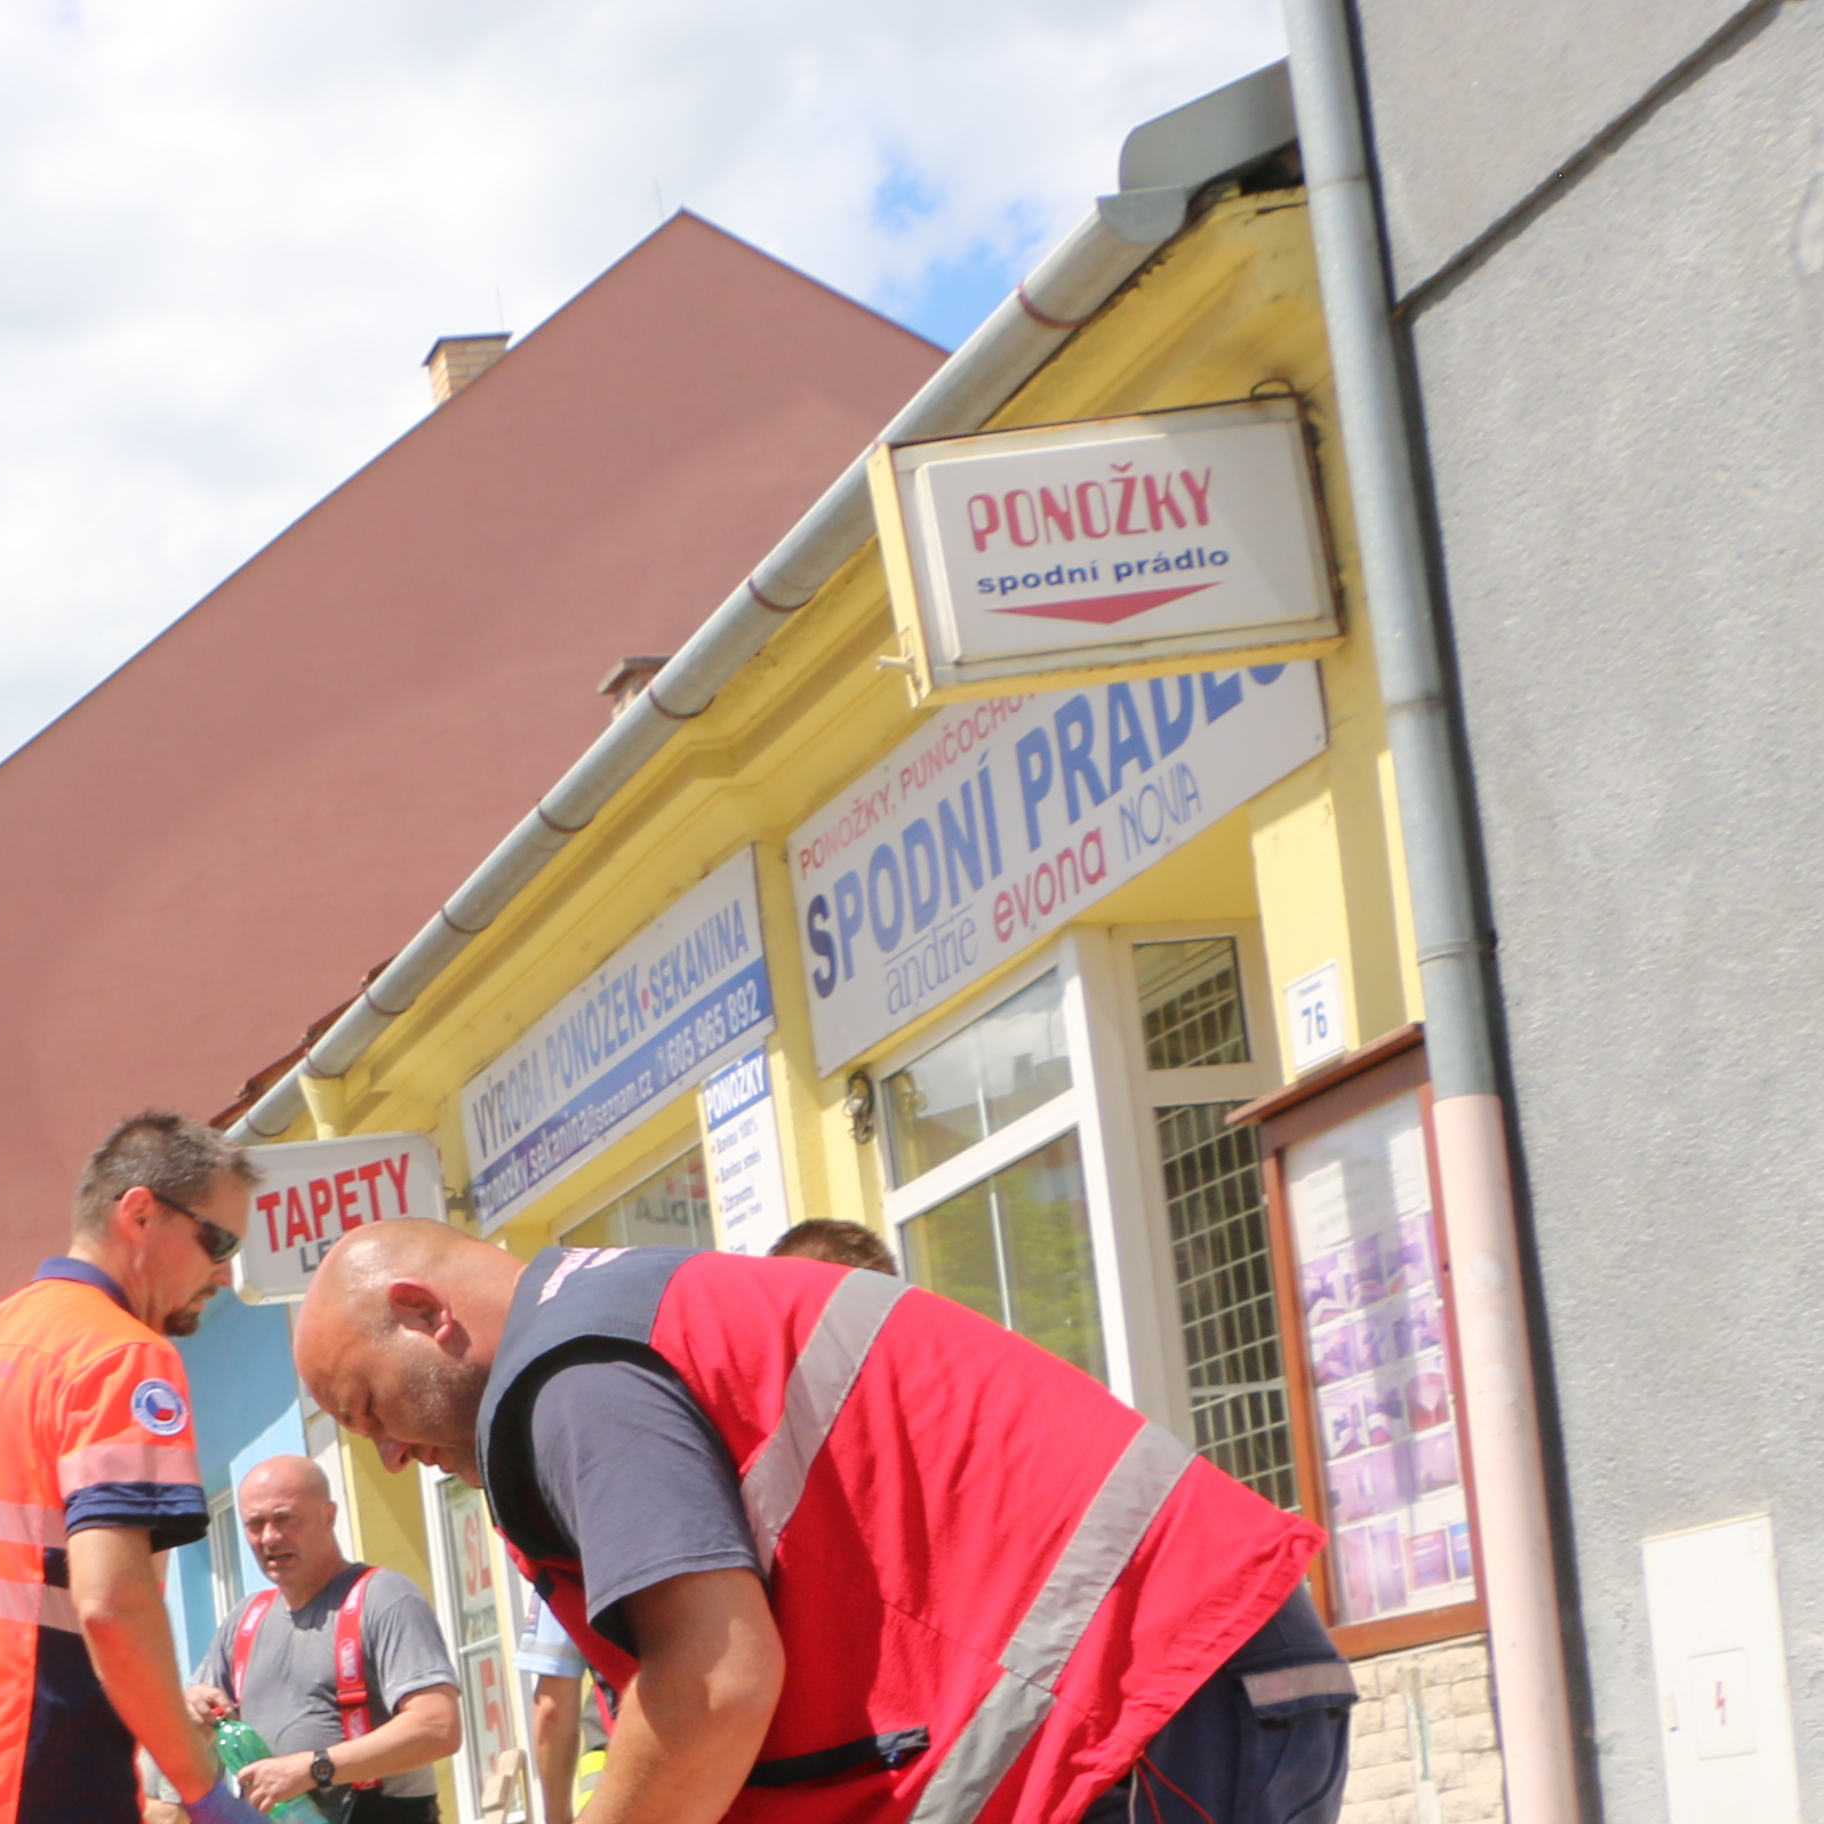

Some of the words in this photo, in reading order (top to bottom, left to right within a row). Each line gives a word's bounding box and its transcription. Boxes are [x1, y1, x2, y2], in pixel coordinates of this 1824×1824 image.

[968, 461, 1212, 552] PONOŽKY
[977, 560, 1100, 595] spodní
[1114, 547, 1230, 583] prádlo
[898, 692, 1037, 803] PUNČOCHO
[806, 747, 1003, 999] SPODNÍ
[993, 826, 1108, 943] evona
[472, 1050, 547, 1159] VÝROBA
[544, 962, 646, 1100] PONOŽEK
[648, 898, 749, 1020] SEKANINA
[1301, 1001, 1329, 1046] 76
[704, 1054, 766, 1125] PONOŽKY
[256, 1153, 410, 1253] TAPETY
[299, 1235, 342, 1274] LE
